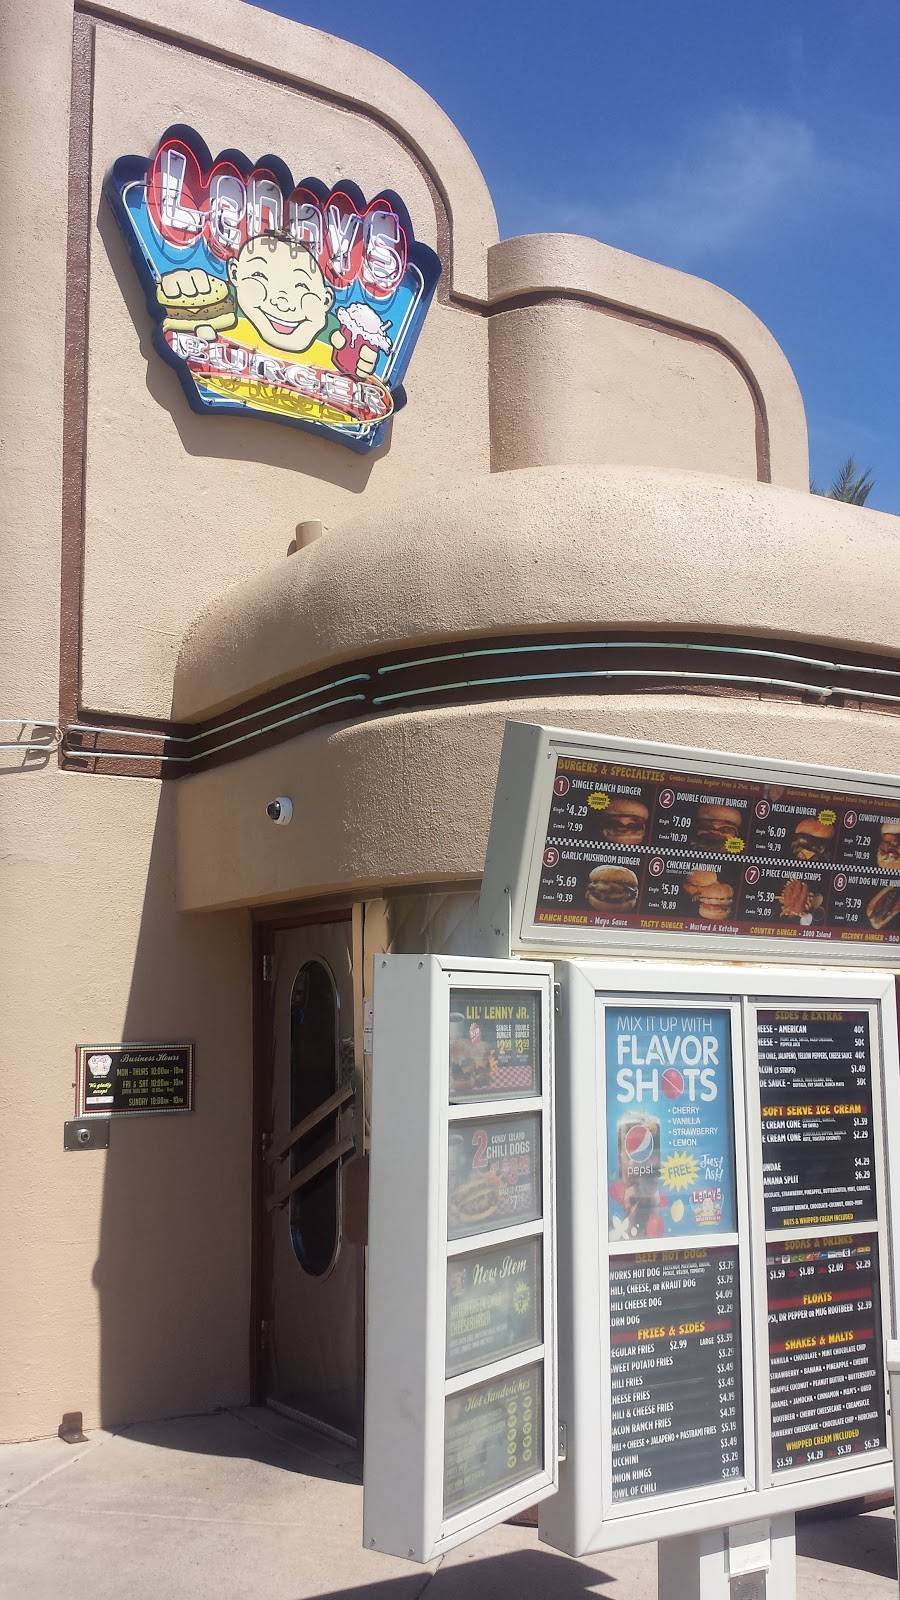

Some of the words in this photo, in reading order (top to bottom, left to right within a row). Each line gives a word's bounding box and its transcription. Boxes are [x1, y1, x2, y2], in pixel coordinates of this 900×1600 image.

[174, 332, 385, 417] BURGER
[558, 760, 598, 774] BURGERS
[601, 767, 607, 775] &
[610, 766, 665, 781] SPECIALTIES
[558, 781, 564, 791] 1
[572, 780, 593, 790] SINGLE
[594, 783, 615, 793] RANCH
[617, 785, 642, 796] BURGER
[664, 793, 670, 804] 2
[677, 792, 699, 802] DOUBLE
[700, 796, 725, 805] COUNTRY
[726, 799, 747, 808] BURGER
[566, 804, 588, 817] $4.29
[760, 805, 765, 814] 3
[772, 804, 794, 814] MEXICAN
[796, 806, 817, 816] BURGER
[673, 816, 691, 827] $7.09
[847, 815, 853, 824] 4
[859, 814, 879, 822] COWBOY
[568, 822, 583, 832] $7.99
[768, 826, 786, 838] $6.09
[670, 833, 687, 842] $10.79
[547, 851, 554, 863] 5
[562, 851, 582, 860] GARLIC
[583, 854, 616, 863] MUSHROOM
[617, 857, 641, 866] BURGER
[653, 862, 660, 872] 6
[667, 860, 690, 869] CHICKEN
[691, 862, 722, 872] SANDWICH
[556, 875, 577, 887] $5.69
[750, 870, 756, 880] 7
[766, 869, 780, 878] PIECE
[781, 871, 803, 880] CHICKEN
[804, 872, 822, 881] STRIPS
[837, 877, 843, 887] 8
[860, 877, 871, 885] DOG
[662, 883, 679, 895] $5.19
[557, 892, 573, 902] $9.39
[757, 892, 775, 902] $5.39
[757, 907, 772, 916] $9.09
[641, 920, 659, 929] TASTY
[751, 927, 775, 936] COUNTRY
[484, 1006, 513, 1020] LENNY
[617, 1016, 643, 1031] MIX
[646, 1016, 656, 1031] IT
[660, 1017, 677, 1032] UP
[681, 1017, 712, 1032] WITH
[779, 1025, 807, 1033] AMERICAN
[617, 1034, 719, 1065] FLAVOR
[120, 1054, 155, 1063] Business
[156, 1053, 179, 1061] Hours
[769, 1079, 786, 1087] SAUCE
[129, 1097, 148, 1106] SUNDAY
[672, 1106, 700, 1115] CHERRY
[763, 1106, 783, 1116] SOFT
[787, 1105, 812, 1116] SERVE
[816, 1105, 831, 1115] ICE
[834, 1104, 861, 1114] CREAM
[766, 1121, 785, 1129] CREAM
[787, 1120, 801, 1128] CONE
[673, 1139, 697, 1147] LEMON
[767, 1133, 786, 1143] CREAM
[787, 1133, 801, 1142] CONE
[472, 1130, 488, 1169] 2
[486, 1144, 507, 1159] CHILI
[510, 1141, 530, 1156] DOGS
[627, 1165, 653, 1176] pepsi
[784, 1175, 799, 1184] SPLIT
[633, 1269, 645, 1278] HOT
[647, 1267, 660, 1277] DOG
[770, 1270, 785, 1280] $1.59
[799, 1266, 815, 1277] $1.89
[627, 1284, 651, 1294] CHEESE,
[661, 1280, 681, 1290] KRAUT
[683, 1279, 696, 1288] DOG
[625, 1299, 648, 1309] CHEESE
[649, 1297, 662, 1307] DOG
[803, 1292, 833, 1305] FLOATS
[788, 1311, 807, 1320] PEPPER
[815, 1307, 827, 1316] MUG
[828, 1304, 853, 1314] ROOTBEER
[627, 1315, 640, 1325] DOG
[638, 1327, 665, 1340] FRIES
[669, 1326, 675, 1336] &
[679, 1322, 705, 1335] SIDES
[638, 1343, 655, 1354] FRIES
[669, 1339, 687, 1351] $2.99
[700, 1337, 714, 1346] LARGE
[785, 1338, 816, 1350] SHAKES
[829, 1331, 854, 1341] MALTS
[770, 1357, 789, 1365] VANILLA
[793, 1352, 817, 1362] CHOCOLATE
[833, 1345, 856, 1355] CHOCOLATE
[632, 1359, 655, 1370] POTATO
[656, 1356, 673, 1367] FRIES
[803, 1365, 822, 1374] BANANA
[826, 1361, 849, 1371] PINEAPPLE
[853, 1357, 869, 1366] CHERRY
[626, 1376, 643, 1387] FRIES
[813, 1378, 828, 1387] PEANUT
[633, 1390, 651, 1401] FRIES
[626, 1409, 631, 1417] &
[633, 1405, 655, 1417] CHEESE
[657, 1402, 674, 1413] FRIES
[800, 1409, 816, 1418] CHERRY
[817, 1404, 842, 1415] CHEESECAKE
[631, 1420, 653, 1433] RANCH
[655, 1418, 672, 1428] FRIES
[794, 1423, 818, 1434] CHEESECAKE
[627, 1438, 645, 1449] CHEESE
[680, 1428, 704, 1440] PASTRAMI
[704, 1426, 717, 1435] FRIES
[721, 1422, 737, 1433] $5.19
[786, 1439, 812, 1451] WHIPPED
[813, 1434, 832, 1445] CREAM
[833, 1429, 860, 1441] INCLUDED
[613, 1455, 639, 1467] UCCHINI
[720, 1436, 737, 1449] $3.49
[776, 1457, 793, 1468] $3.59
[807, 1450, 824, 1462] $4.29
[837, 1445, 851, 1455] $5.19
[632, 1468, 652, 1480] RINGS
[722, 1452, 739, 1463] $3.29
[630, 1487, 639, 1495] OF
[640, 1483, 657, 1493] CHILI
[722, 1466, 739, 1479] $2.99
